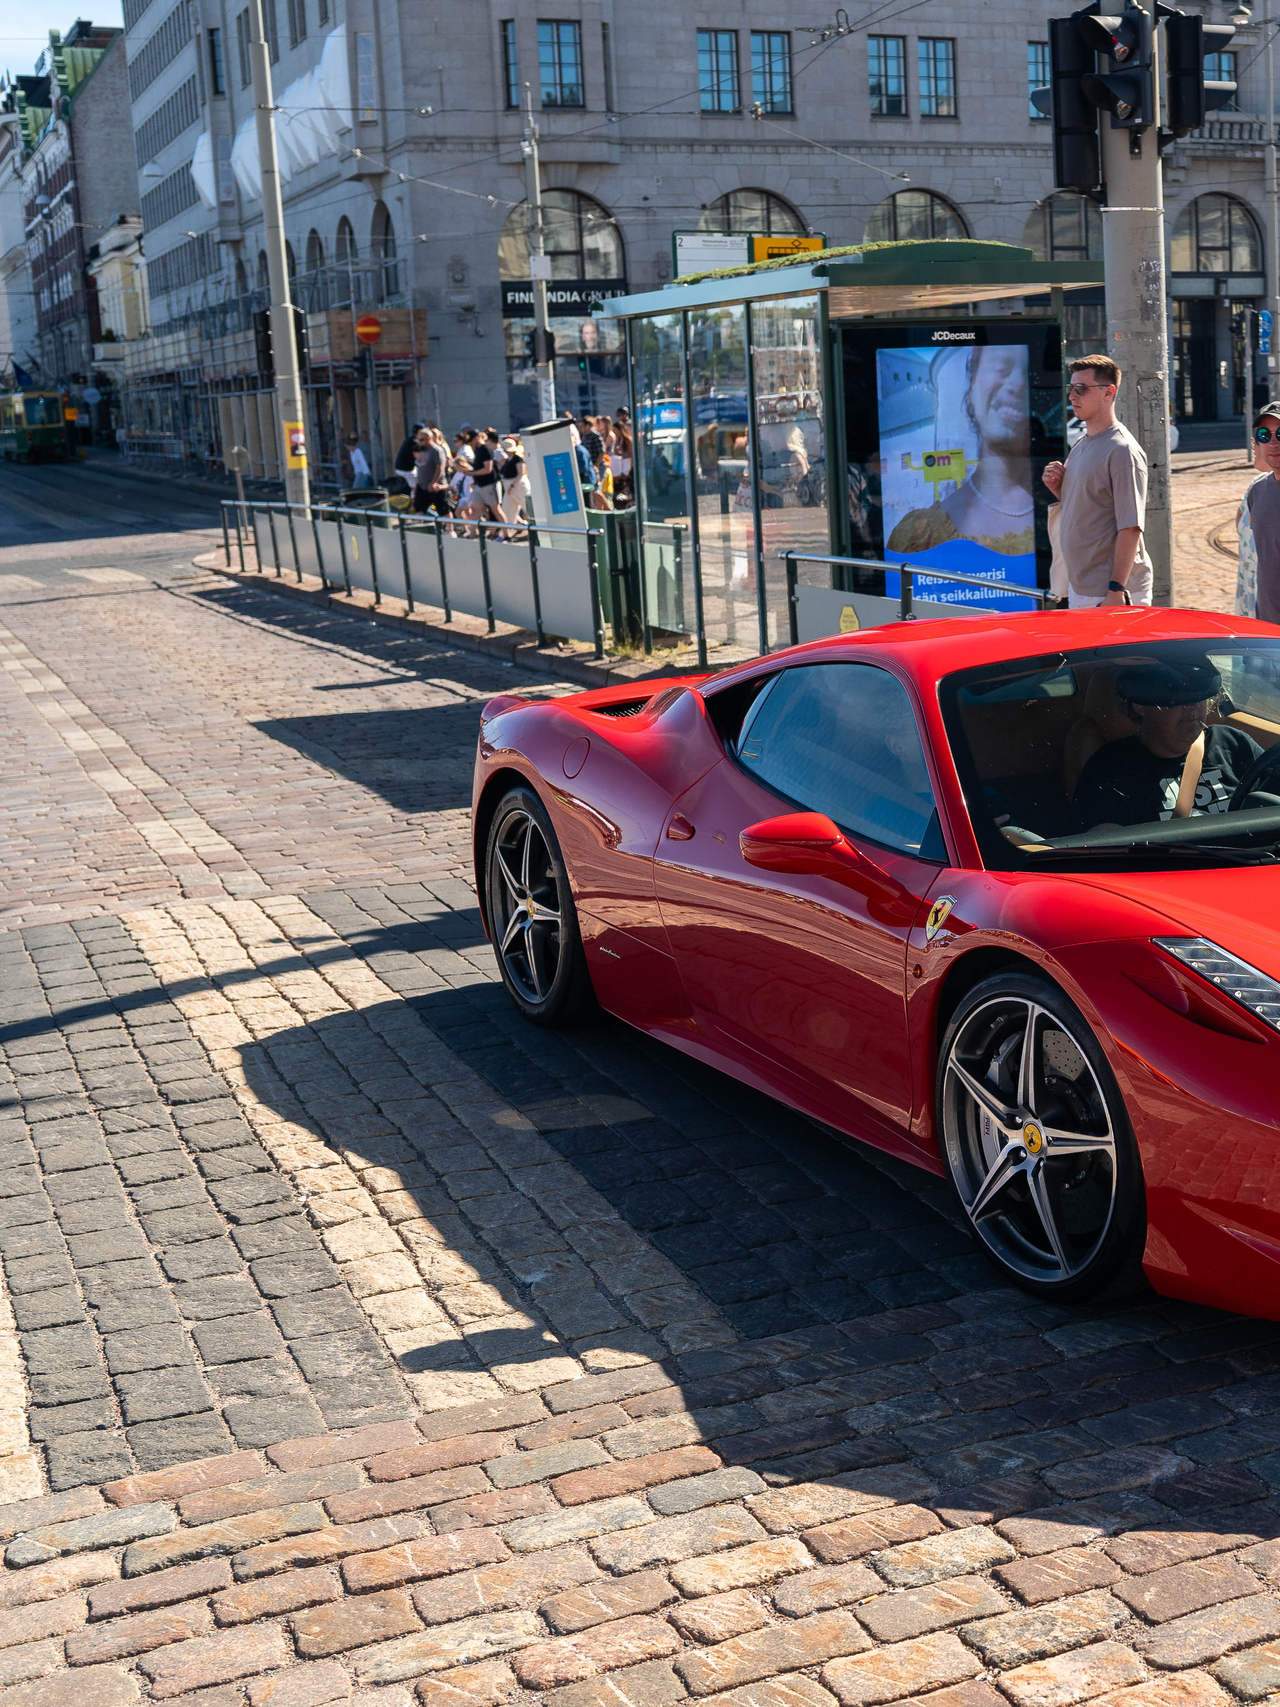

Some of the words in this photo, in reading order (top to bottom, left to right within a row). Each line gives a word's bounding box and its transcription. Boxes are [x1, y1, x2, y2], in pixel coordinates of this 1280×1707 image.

[677, 236, 684, 247] 2
[507, 291, 581, 304] FINLNDIA
[931, 331, 976, 341] JCDecaux
[1159, 769, 1229, 810] JST
